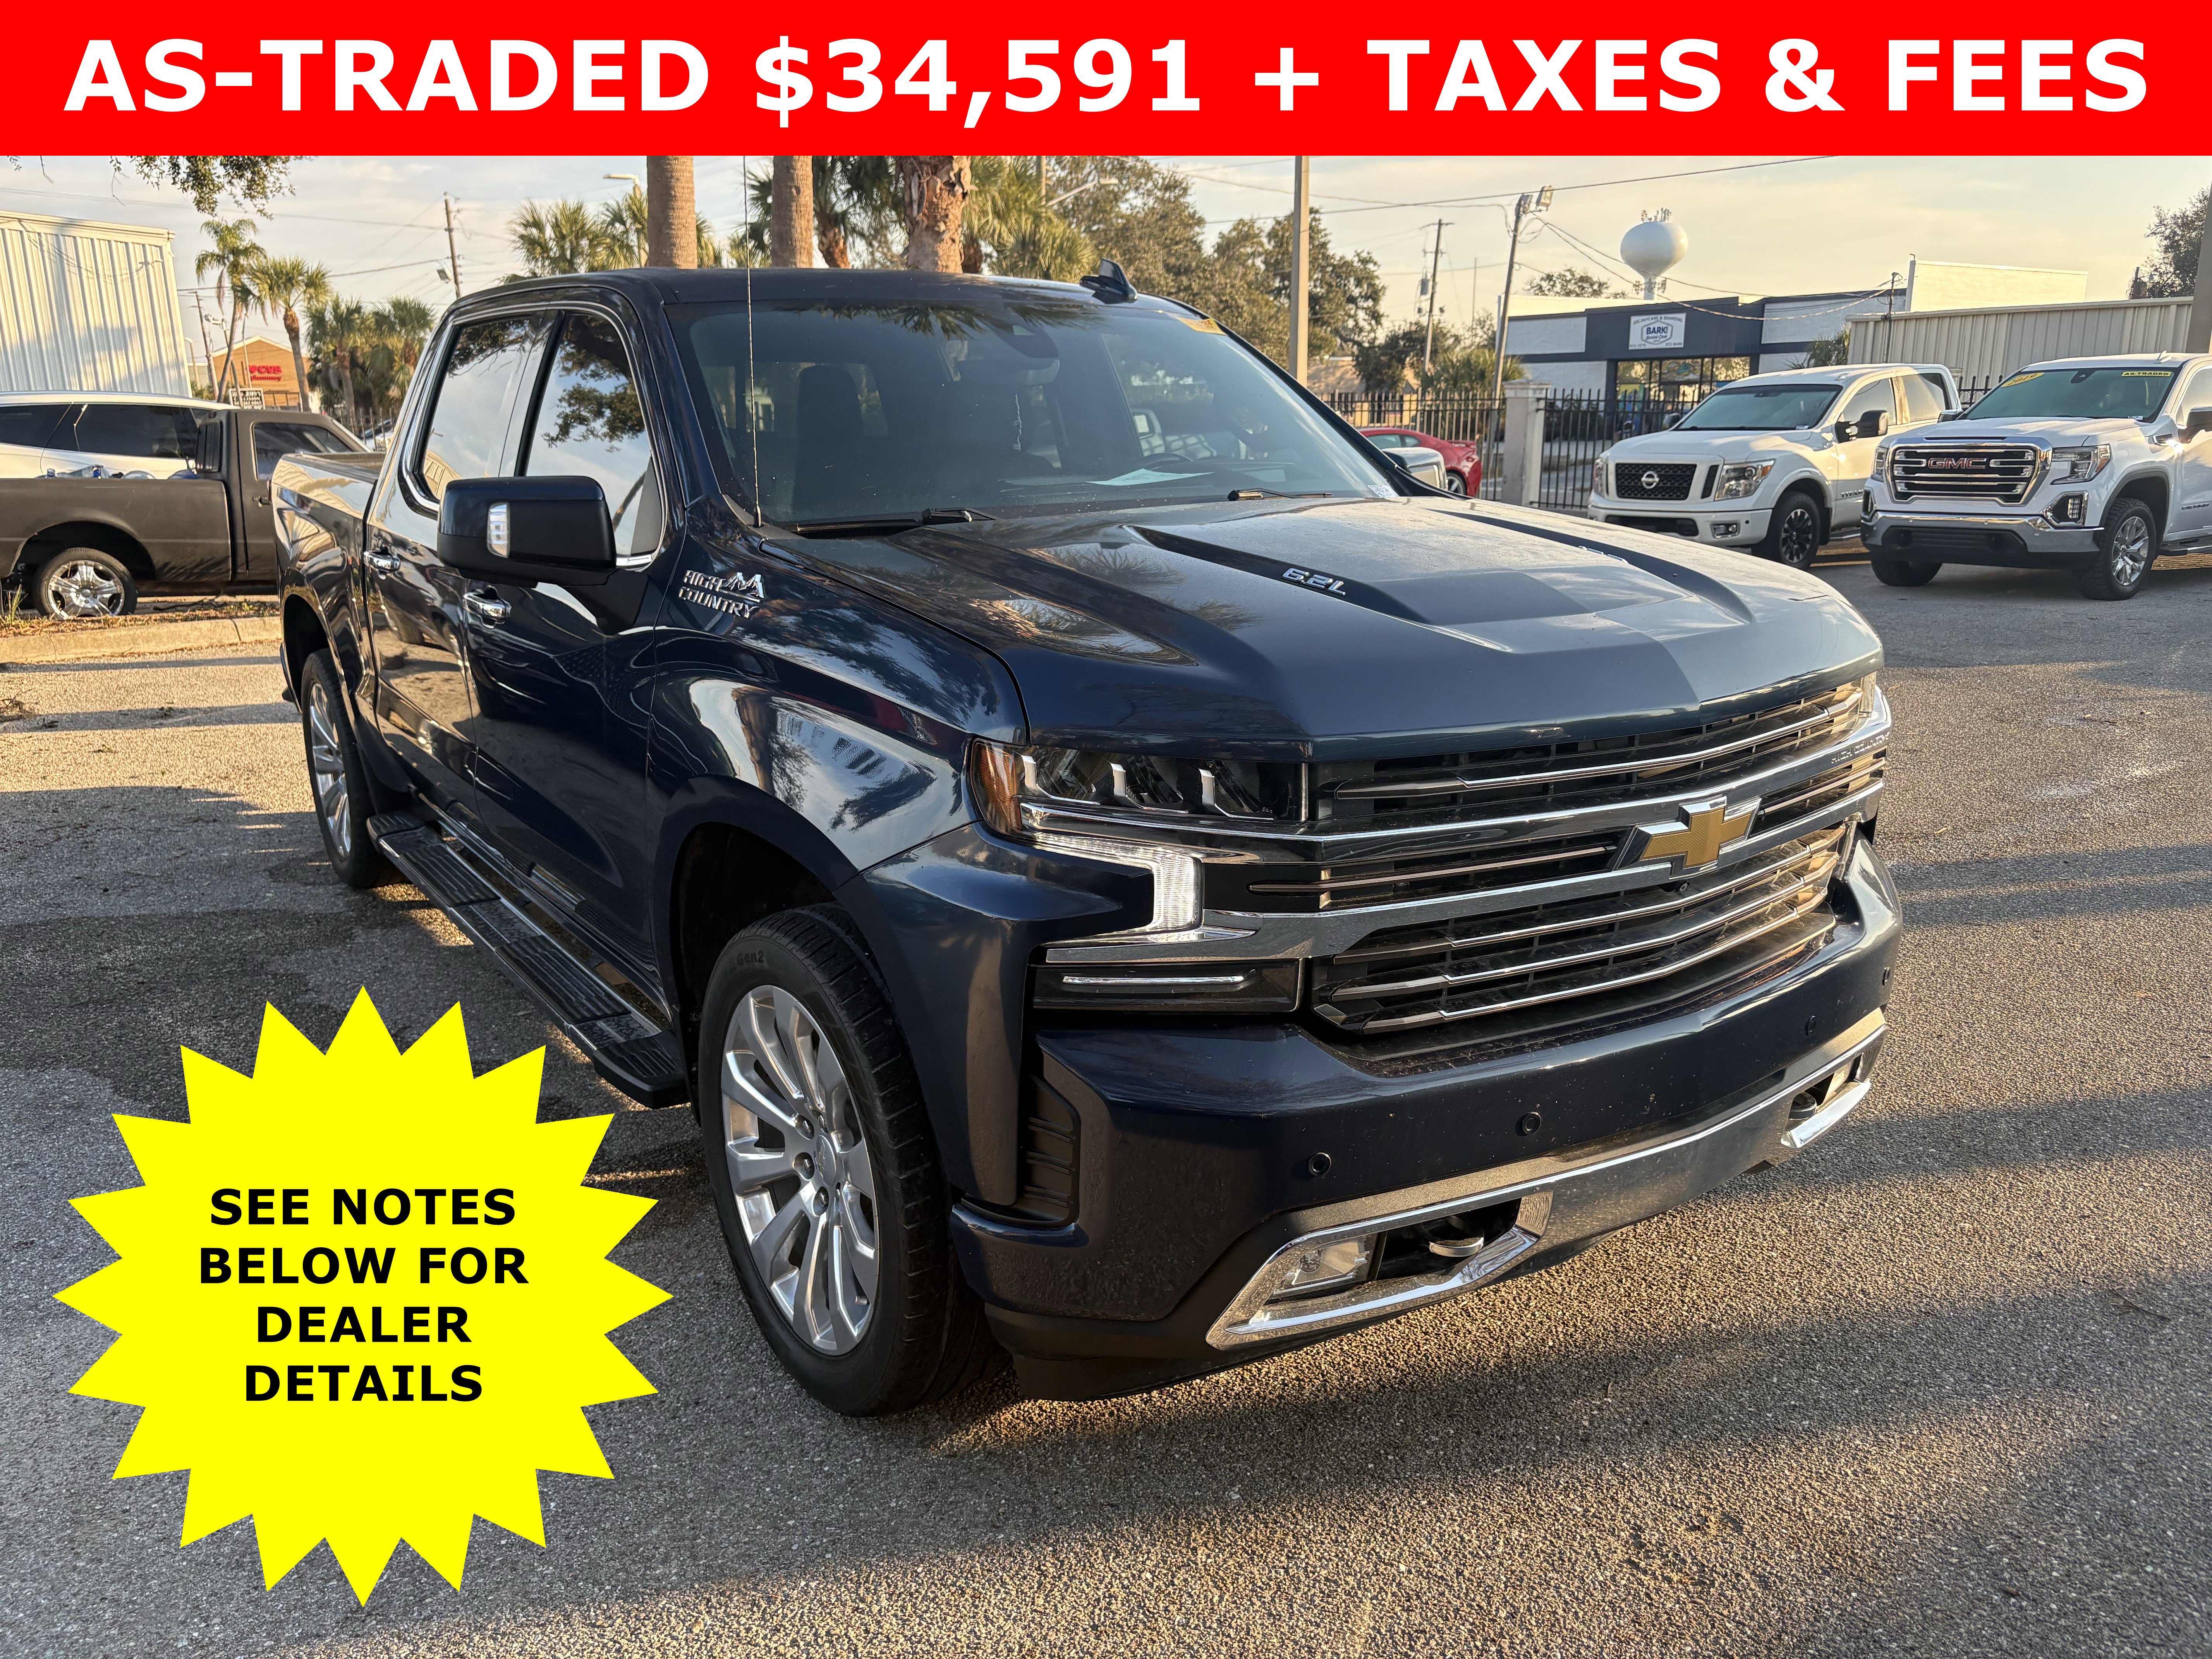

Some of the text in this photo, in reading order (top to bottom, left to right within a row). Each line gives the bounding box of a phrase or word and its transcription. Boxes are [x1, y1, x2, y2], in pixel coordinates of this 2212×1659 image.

[1646, 326, 1668, 335] BARK!
[257, 365, 282, 374] CVS
[1928, 458, 1987, 469] GMC
[684, 570, 726, 592] HIGH
[1282, 568, 1346, 596] 6.2L
[678, 586, 760, 619] COUNTRY
[737, 950, 764, 966] Gen2
